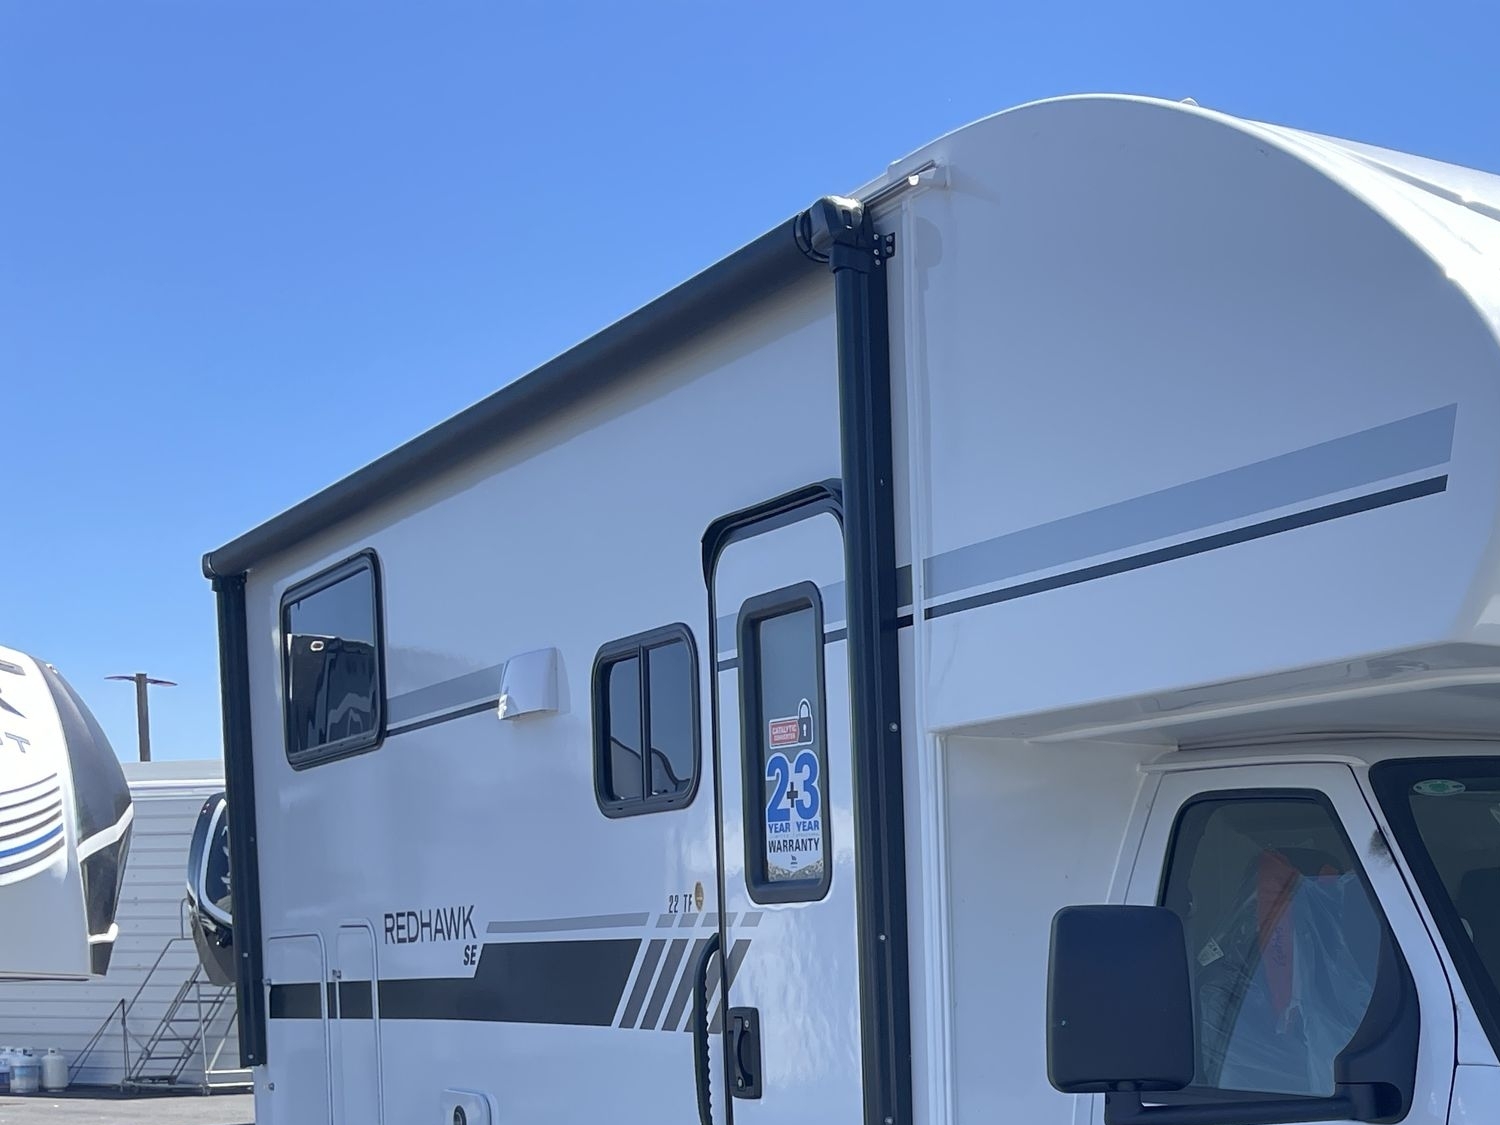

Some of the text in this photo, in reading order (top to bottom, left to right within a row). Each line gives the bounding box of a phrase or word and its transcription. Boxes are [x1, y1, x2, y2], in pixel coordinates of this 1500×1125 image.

[768, 820, 820, 834] YEAR YEAR
[768, 838, 820, 854] WARRANTY
[668, 894, 679, 914] 22
[683, 893, 692, 913] TF
[384, 905, 476, 944] REDHAWK
[463, 944, 477, 966] SE
